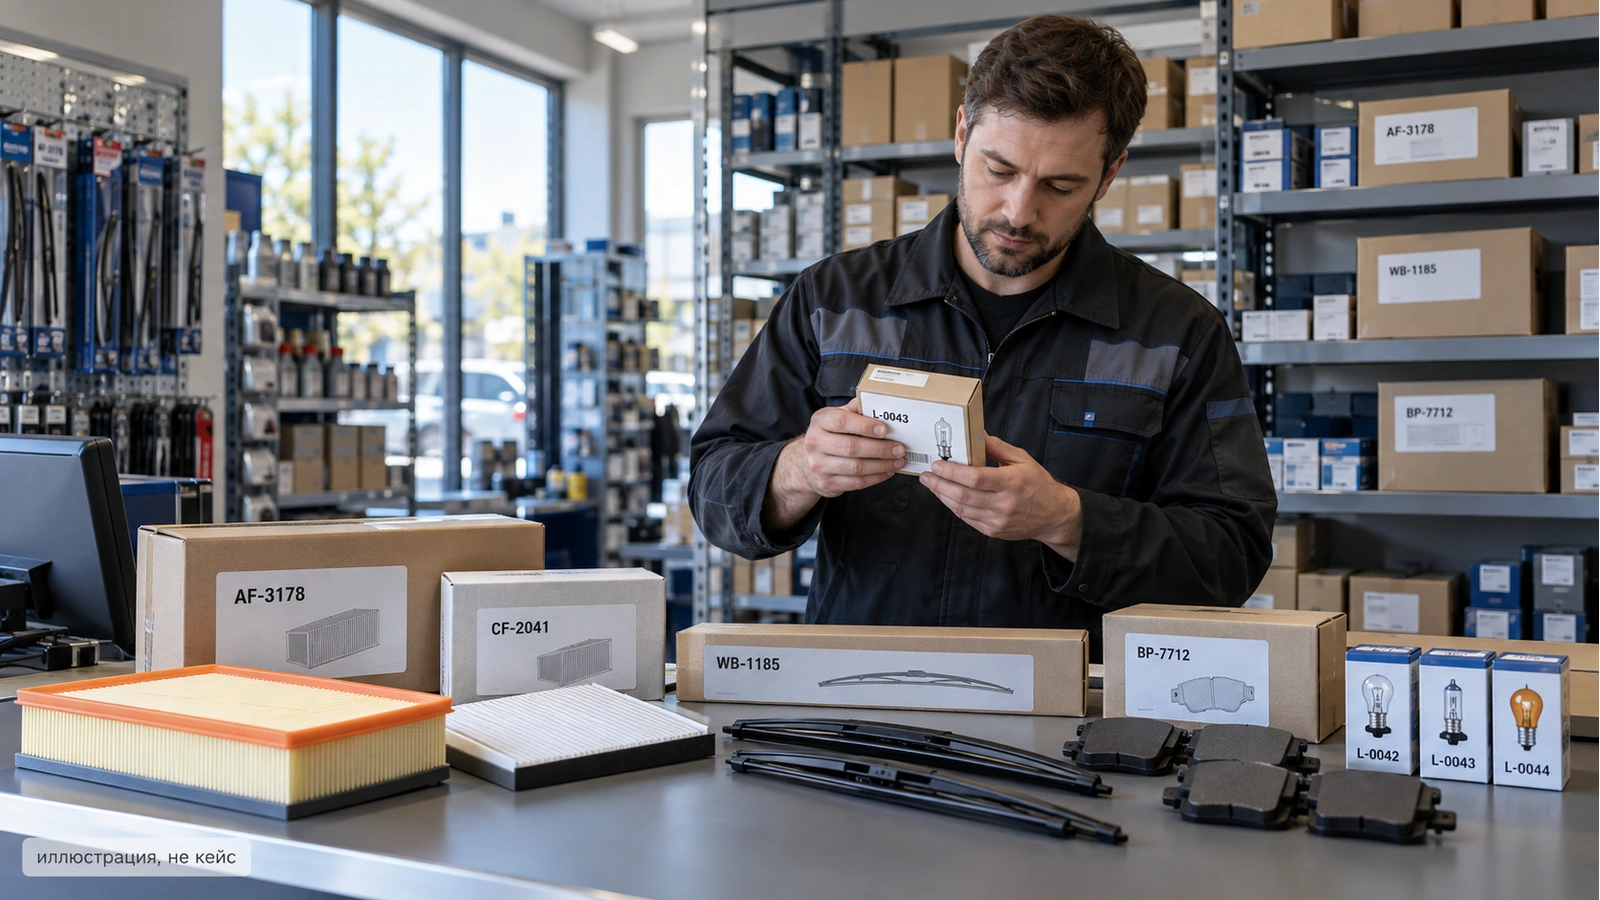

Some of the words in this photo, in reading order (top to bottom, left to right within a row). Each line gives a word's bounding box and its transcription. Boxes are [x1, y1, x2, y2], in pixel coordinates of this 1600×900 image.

[1386, 123, 1435, 137] AF-3178
[1389, 263, 1437, 276] WB-1185
[872, 409, 909, 423] L-0043
[1406, 407, 1453, 418] BP-7712
[234, 585, 306, 605] AF-3178
[491, 620, 549, 636] CF-2041
[1137, 646, 1190, 662] BP-7712
[716, 656, 780, 671] WB-1185
[1357, 747, 1400, 762] L-0042
[1431, 754, 1476, 769] L-0043
[1504, 761, 1550, 777] L-0044
